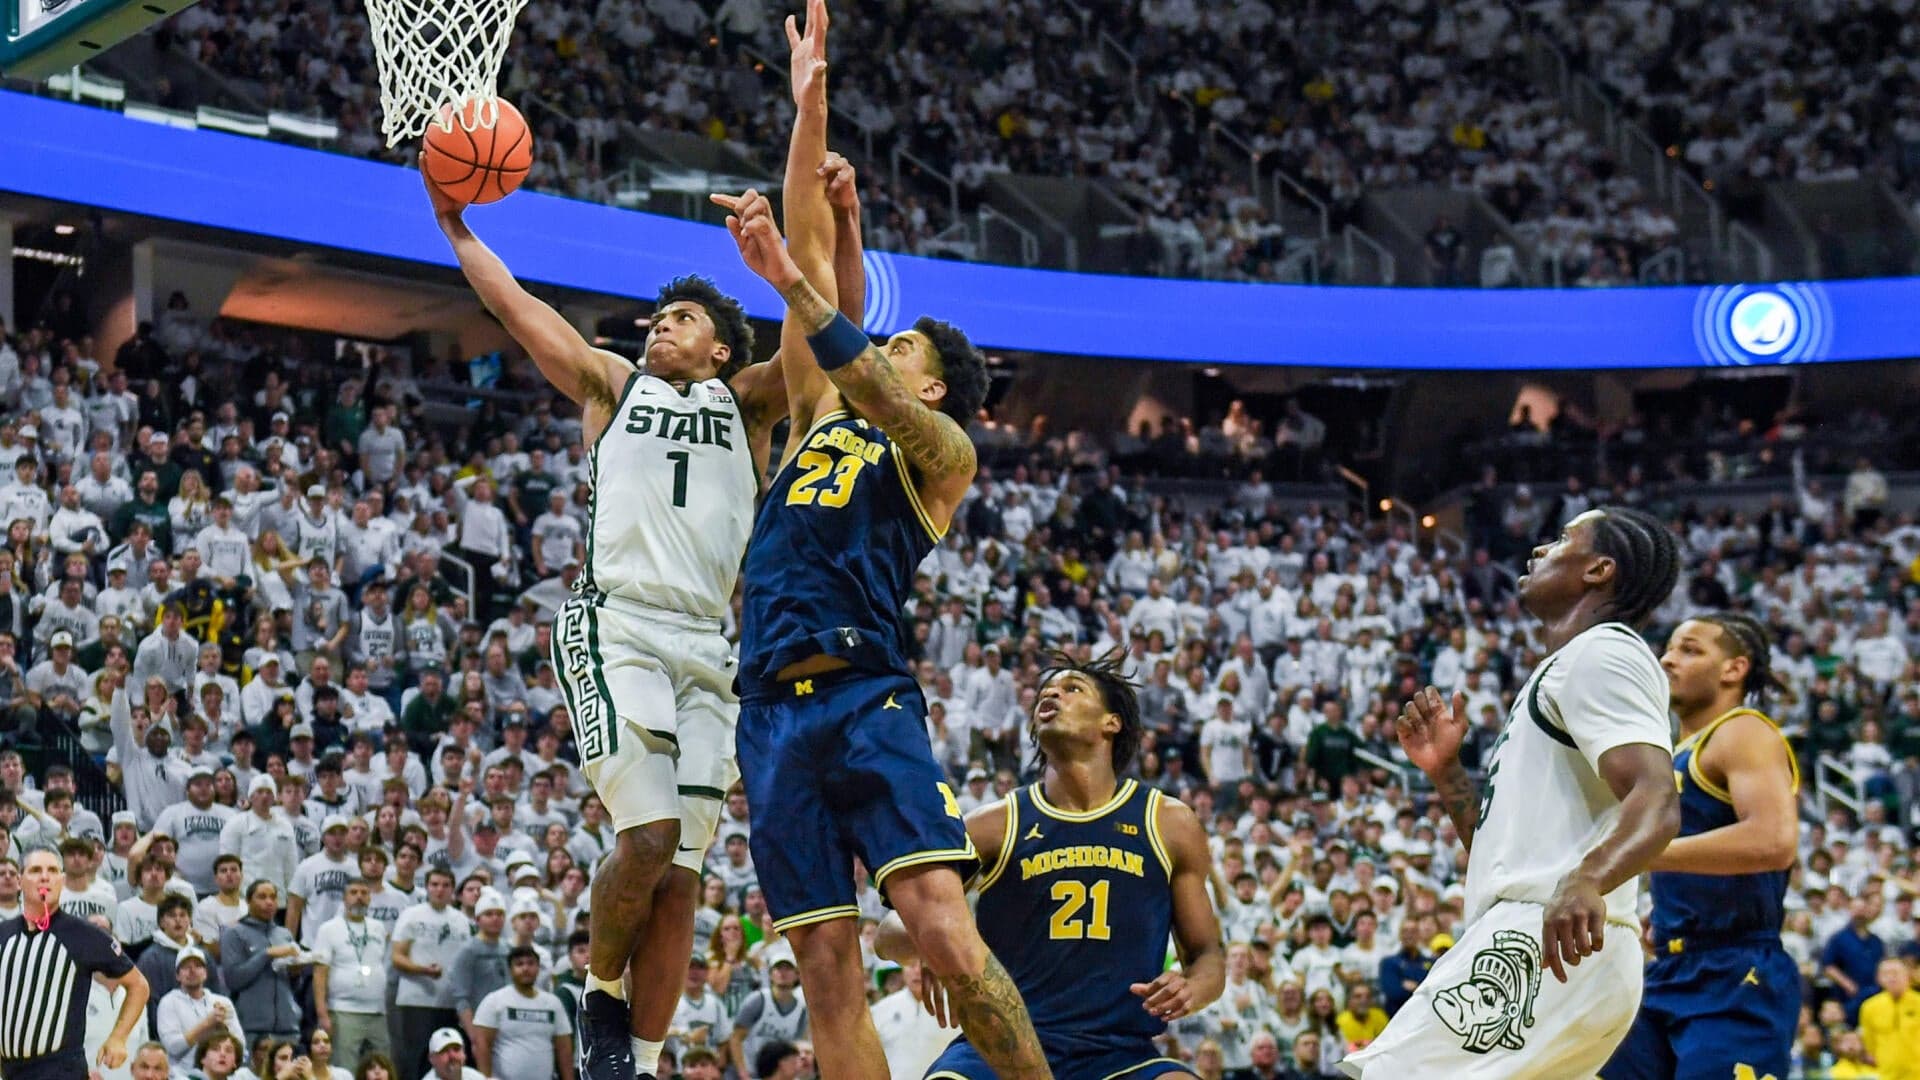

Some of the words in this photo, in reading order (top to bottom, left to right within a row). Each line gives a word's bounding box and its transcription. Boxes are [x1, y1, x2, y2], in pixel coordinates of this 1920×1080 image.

[625, 405, 734, 452] STATE
[666, 450, 689, 508] 1
[785, 449, 866, 508] 23
[795, 679, 814, 696] M
[1020, 845, 1145, 880] MICHIGAN
[1049, 879, 1111, 941] 21
